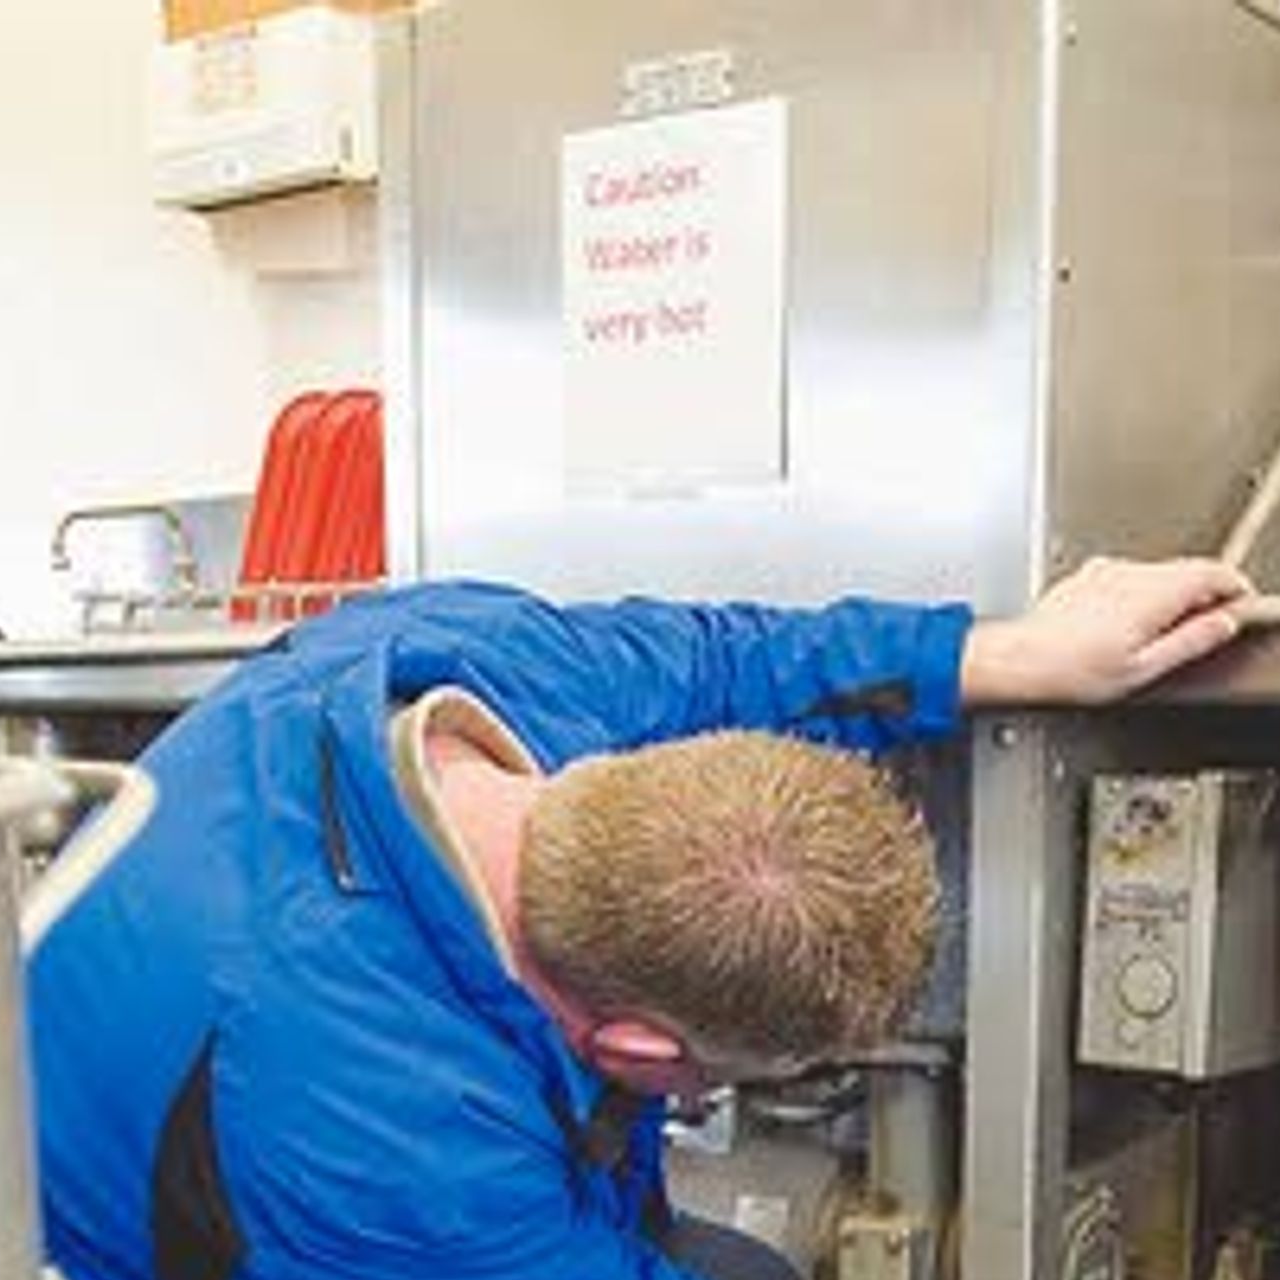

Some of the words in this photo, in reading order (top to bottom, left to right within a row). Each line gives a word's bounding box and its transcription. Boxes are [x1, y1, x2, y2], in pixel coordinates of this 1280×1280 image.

[583, 235, 679, 272] Water
[684, 226, 712, 263] is
[583, 313, 651, 344] very
[658, 299, 710, 336] hot
